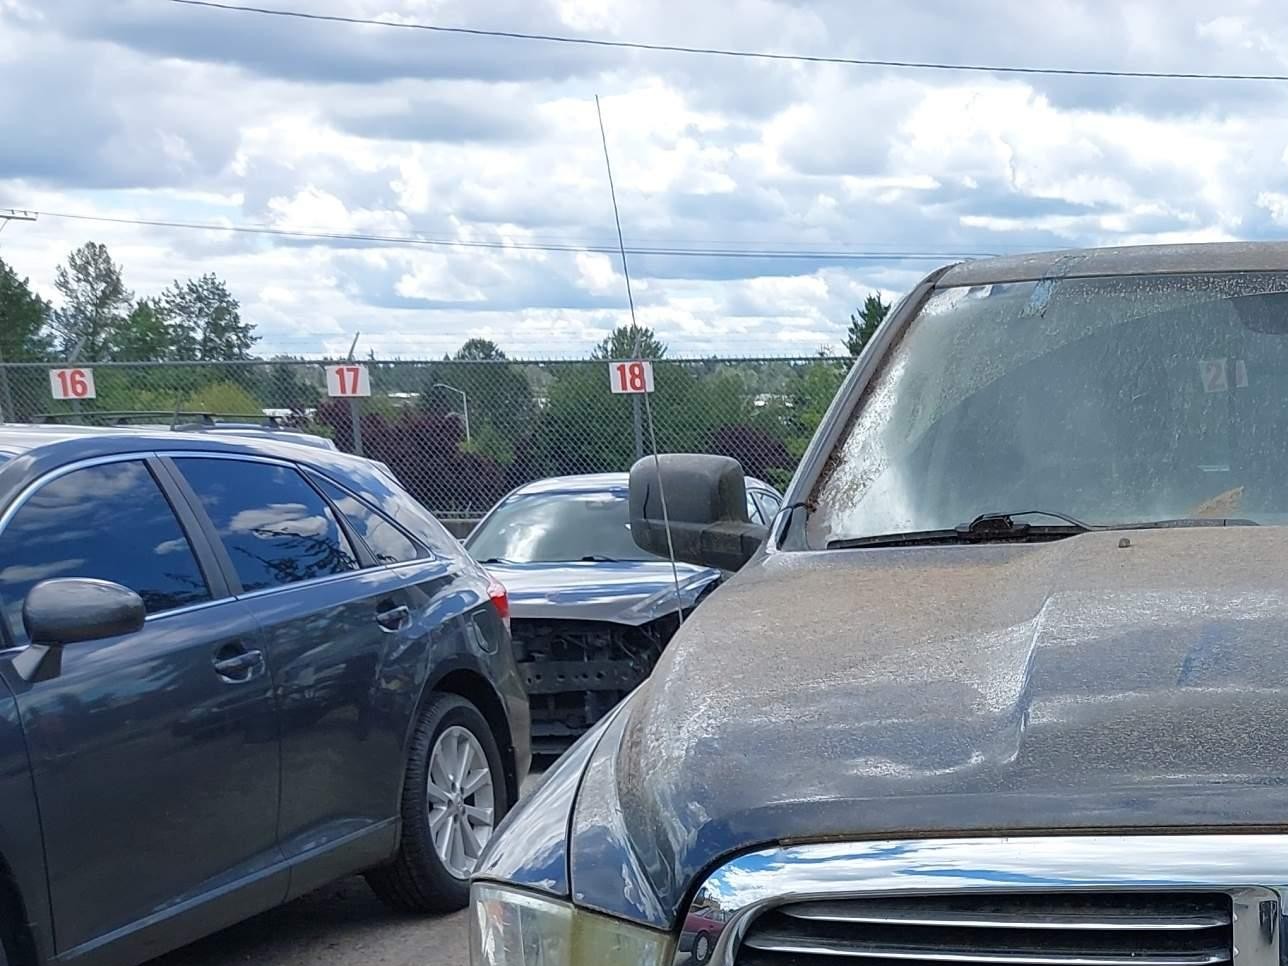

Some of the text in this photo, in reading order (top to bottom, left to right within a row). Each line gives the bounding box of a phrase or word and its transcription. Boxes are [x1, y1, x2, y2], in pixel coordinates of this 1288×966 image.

[57, 370, 88, 397] 16
[336, 367, 359, 394] 17
[617, 363, 646, 391] 18
